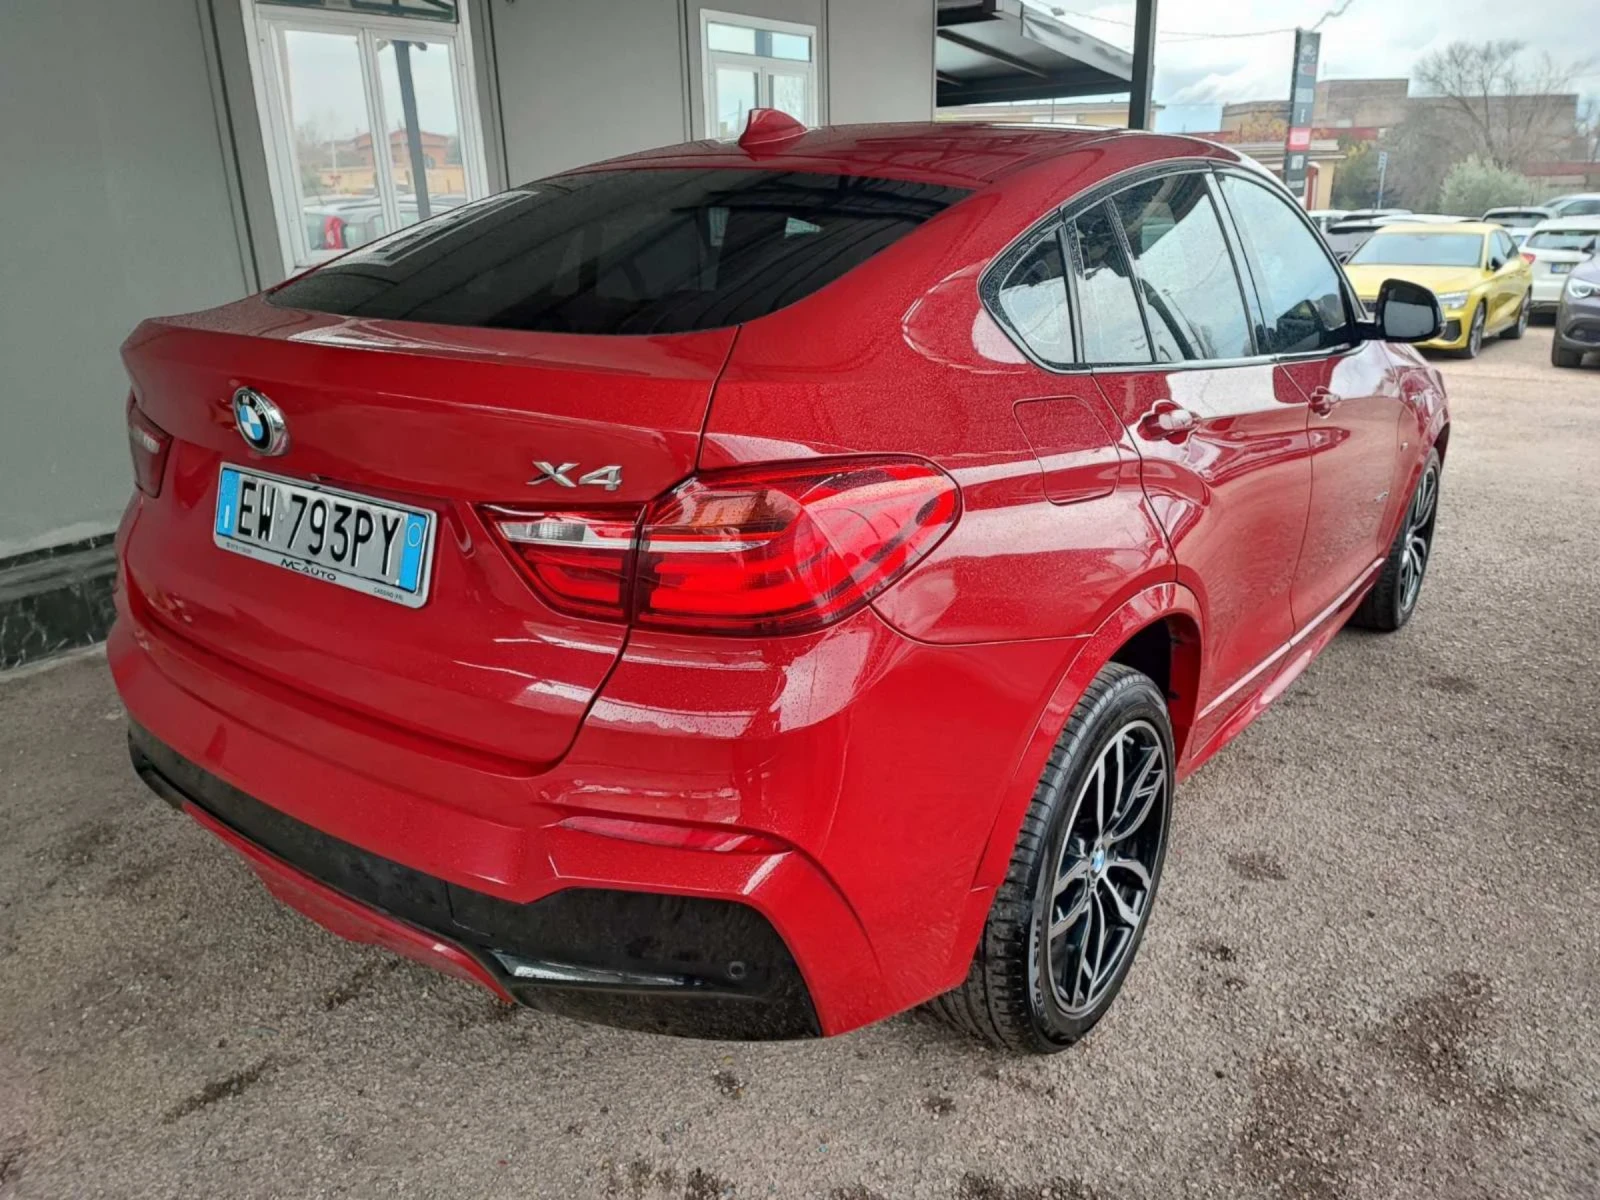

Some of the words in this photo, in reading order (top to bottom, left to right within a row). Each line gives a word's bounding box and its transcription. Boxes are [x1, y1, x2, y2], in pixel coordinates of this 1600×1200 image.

[525, 460, 622, 491] X4
[237, 480, 279, 542] EW
[287, 494, 401, 576] 793PY
